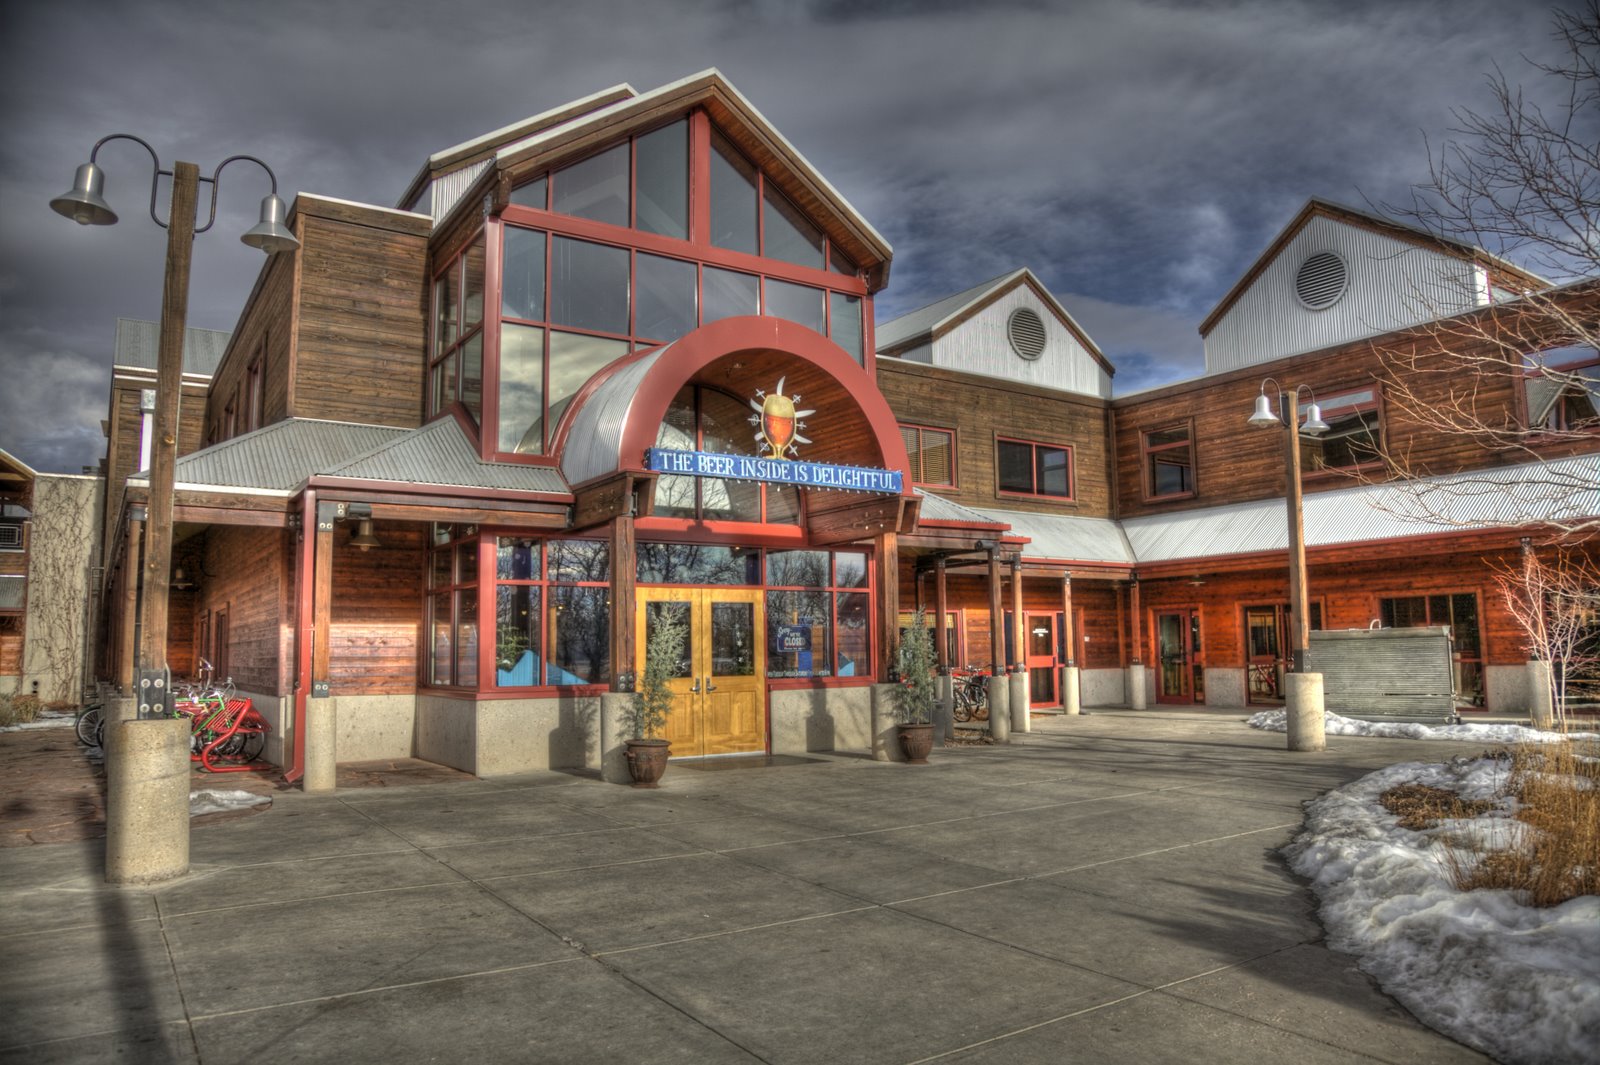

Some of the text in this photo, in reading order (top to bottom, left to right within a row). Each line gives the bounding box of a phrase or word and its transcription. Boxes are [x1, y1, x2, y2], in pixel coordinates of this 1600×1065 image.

[659, 452, 896, 490] THE BEER INSIDE IS DELIGHTFUL
